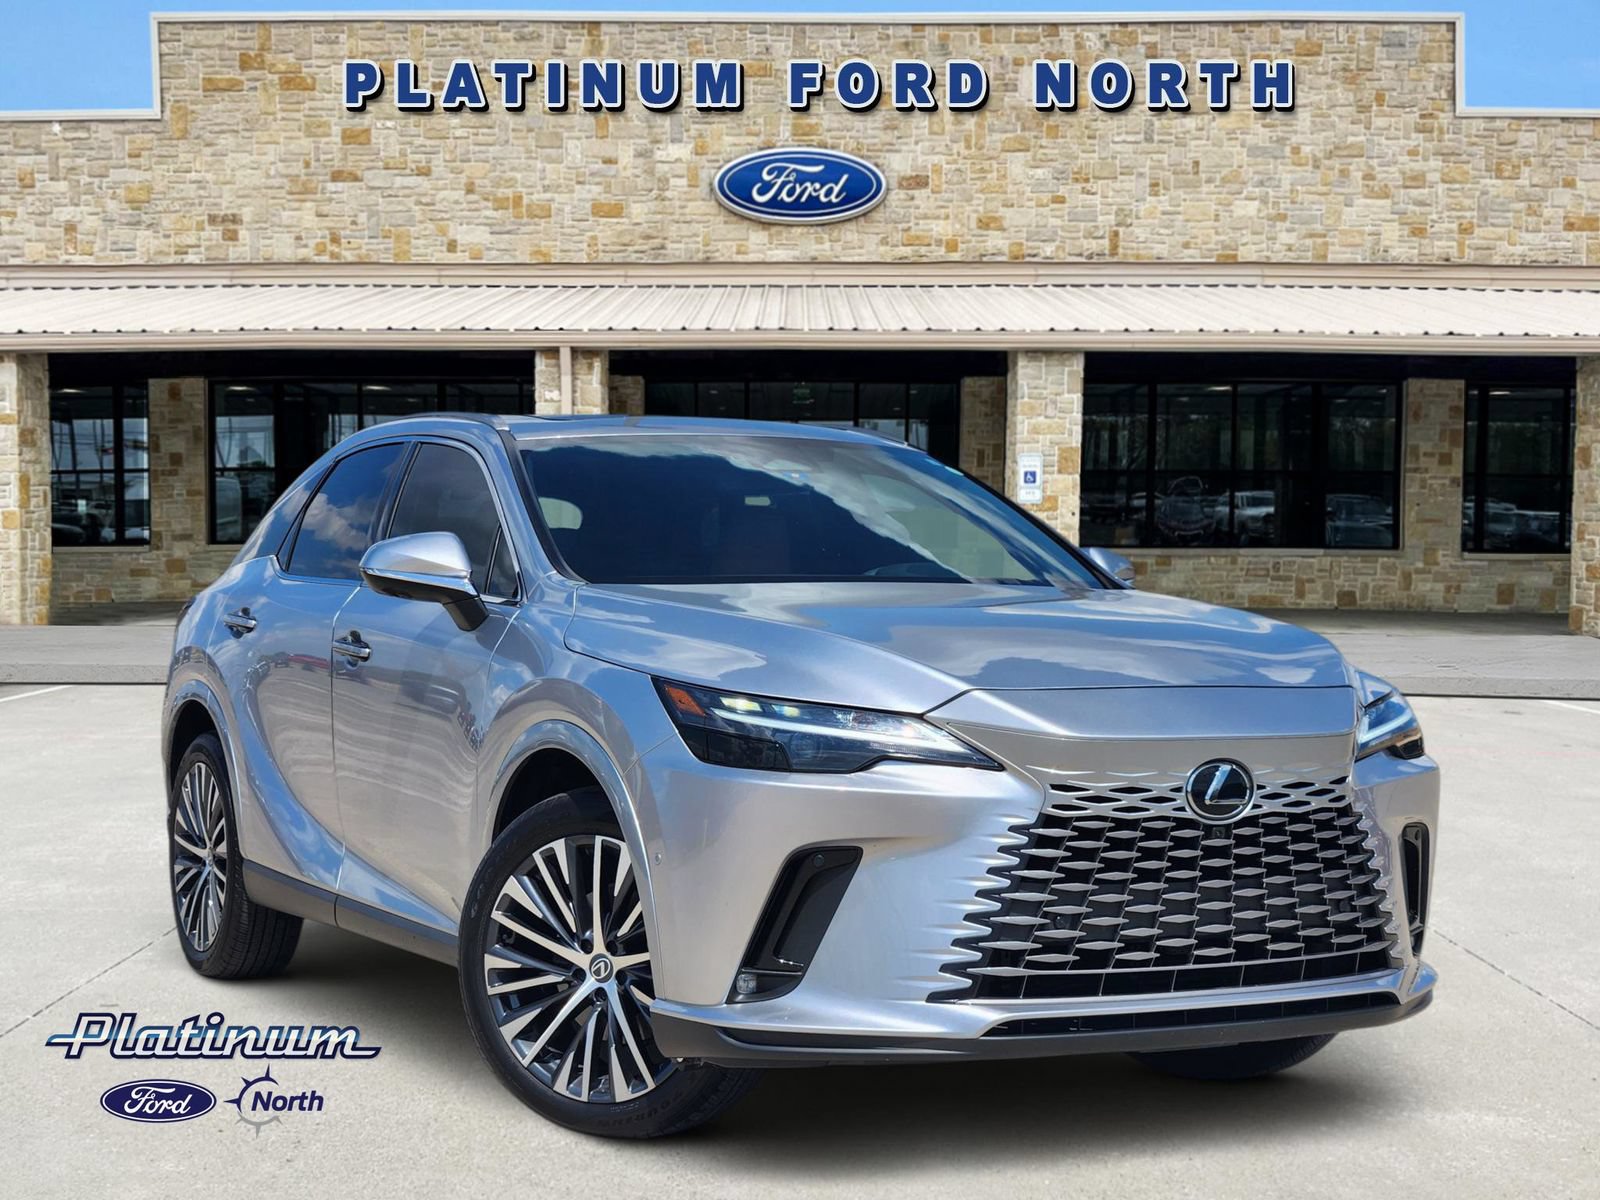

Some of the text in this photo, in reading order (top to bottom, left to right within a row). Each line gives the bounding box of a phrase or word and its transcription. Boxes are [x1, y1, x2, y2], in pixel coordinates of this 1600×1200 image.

[343, 58, 1296, 112] PLATINUM FORD NORTH
[751, 163, 849, 203] Ford
